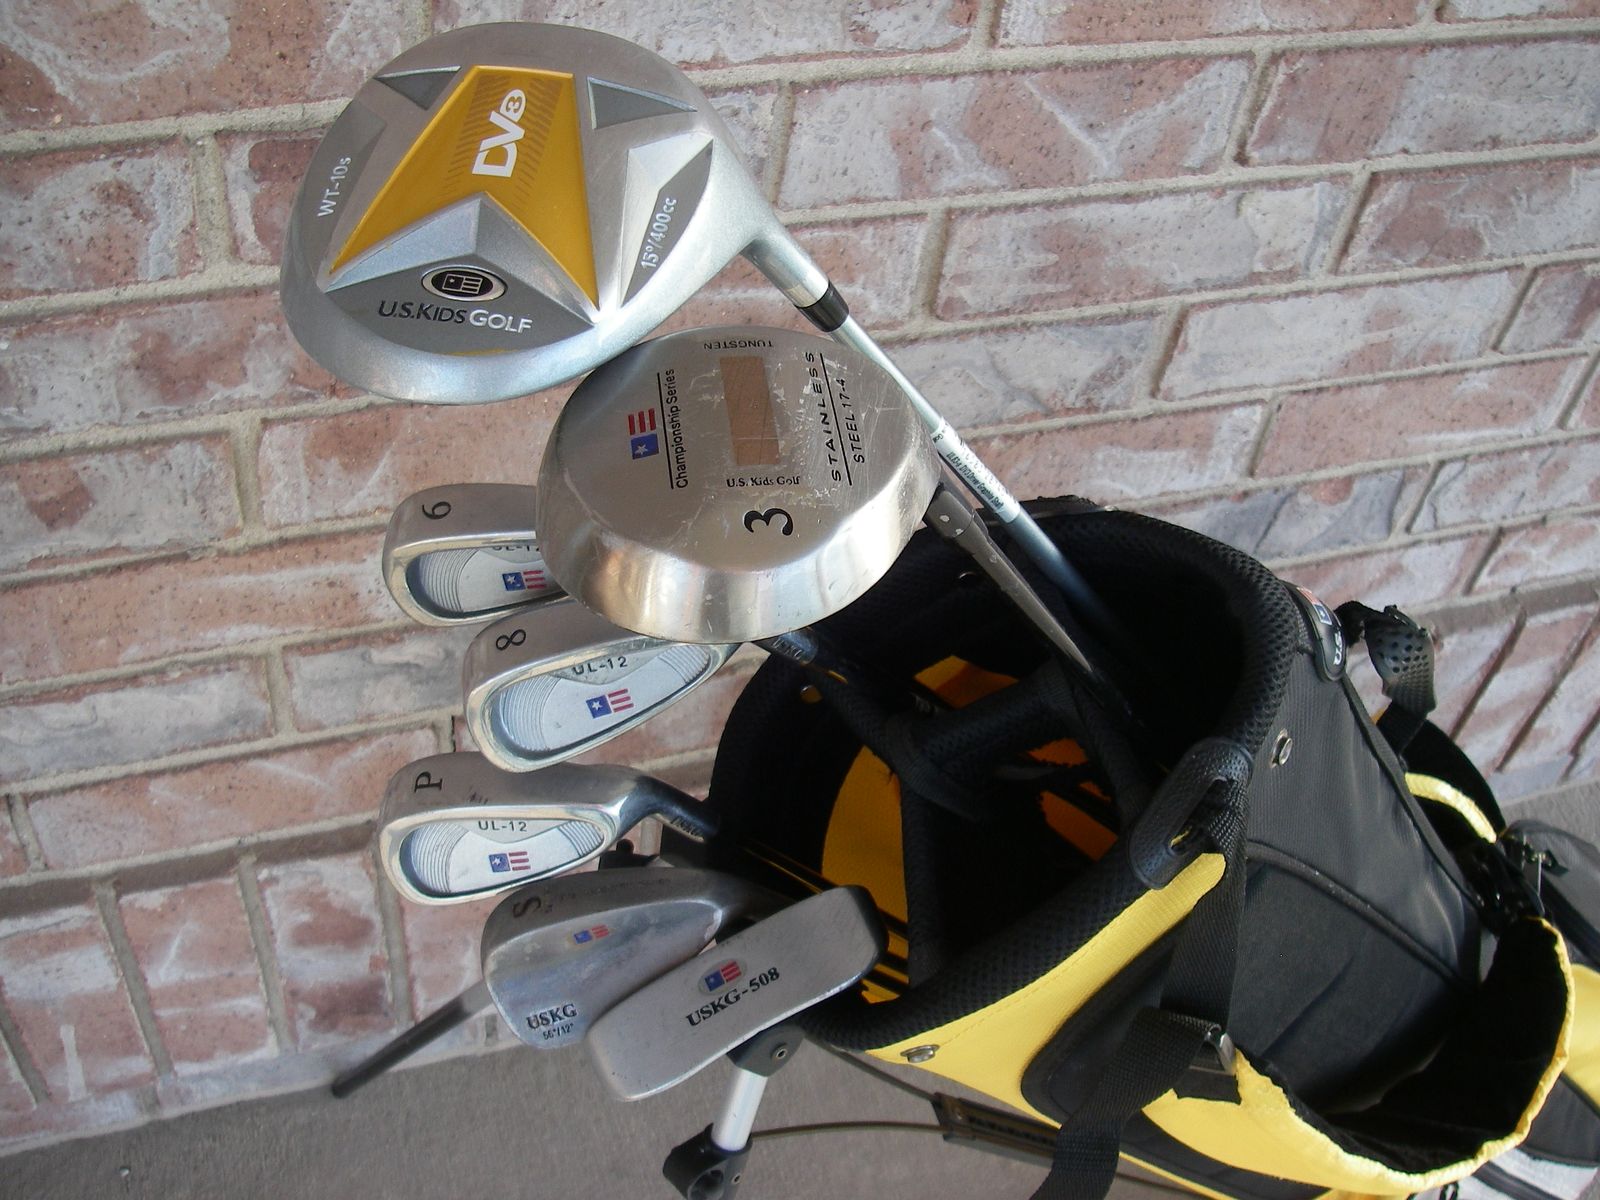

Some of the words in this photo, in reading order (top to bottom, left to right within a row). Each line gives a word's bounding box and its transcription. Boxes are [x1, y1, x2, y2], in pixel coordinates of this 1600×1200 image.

[472, 89, 527, 177] DV3
[317, 157, 351, 216] WT-10s
[469, 309, 533, 333] GOLF
[704, 339, 774, 350] TUNGSTEN
[665, 368, 678, 405] Series
[836, 378, 852, 408] 17-4
[805, 351, 842, 482] STAINLESS
[668, 405, 689, 489] Championship
[845, 413, 865, 464] STEEL
[726, 478, 749, 488] U.S.
[750, 476, 774, 487] Kids
[776, 475, 801, 486] Golf
[422, 500, 452, 521] 6
[743, 507, 794, 536] 3
[495, 628, 527, 652] 8
[572, 655, 628, 675] UL-12
[414, 771, 443, 793] P
[478, 820, 528, 832] UL-12
[512, 896, 542, 918] S
[685, 966, 780, 1027] USKG-508
[526, 1003, 577, 1029] USKG
